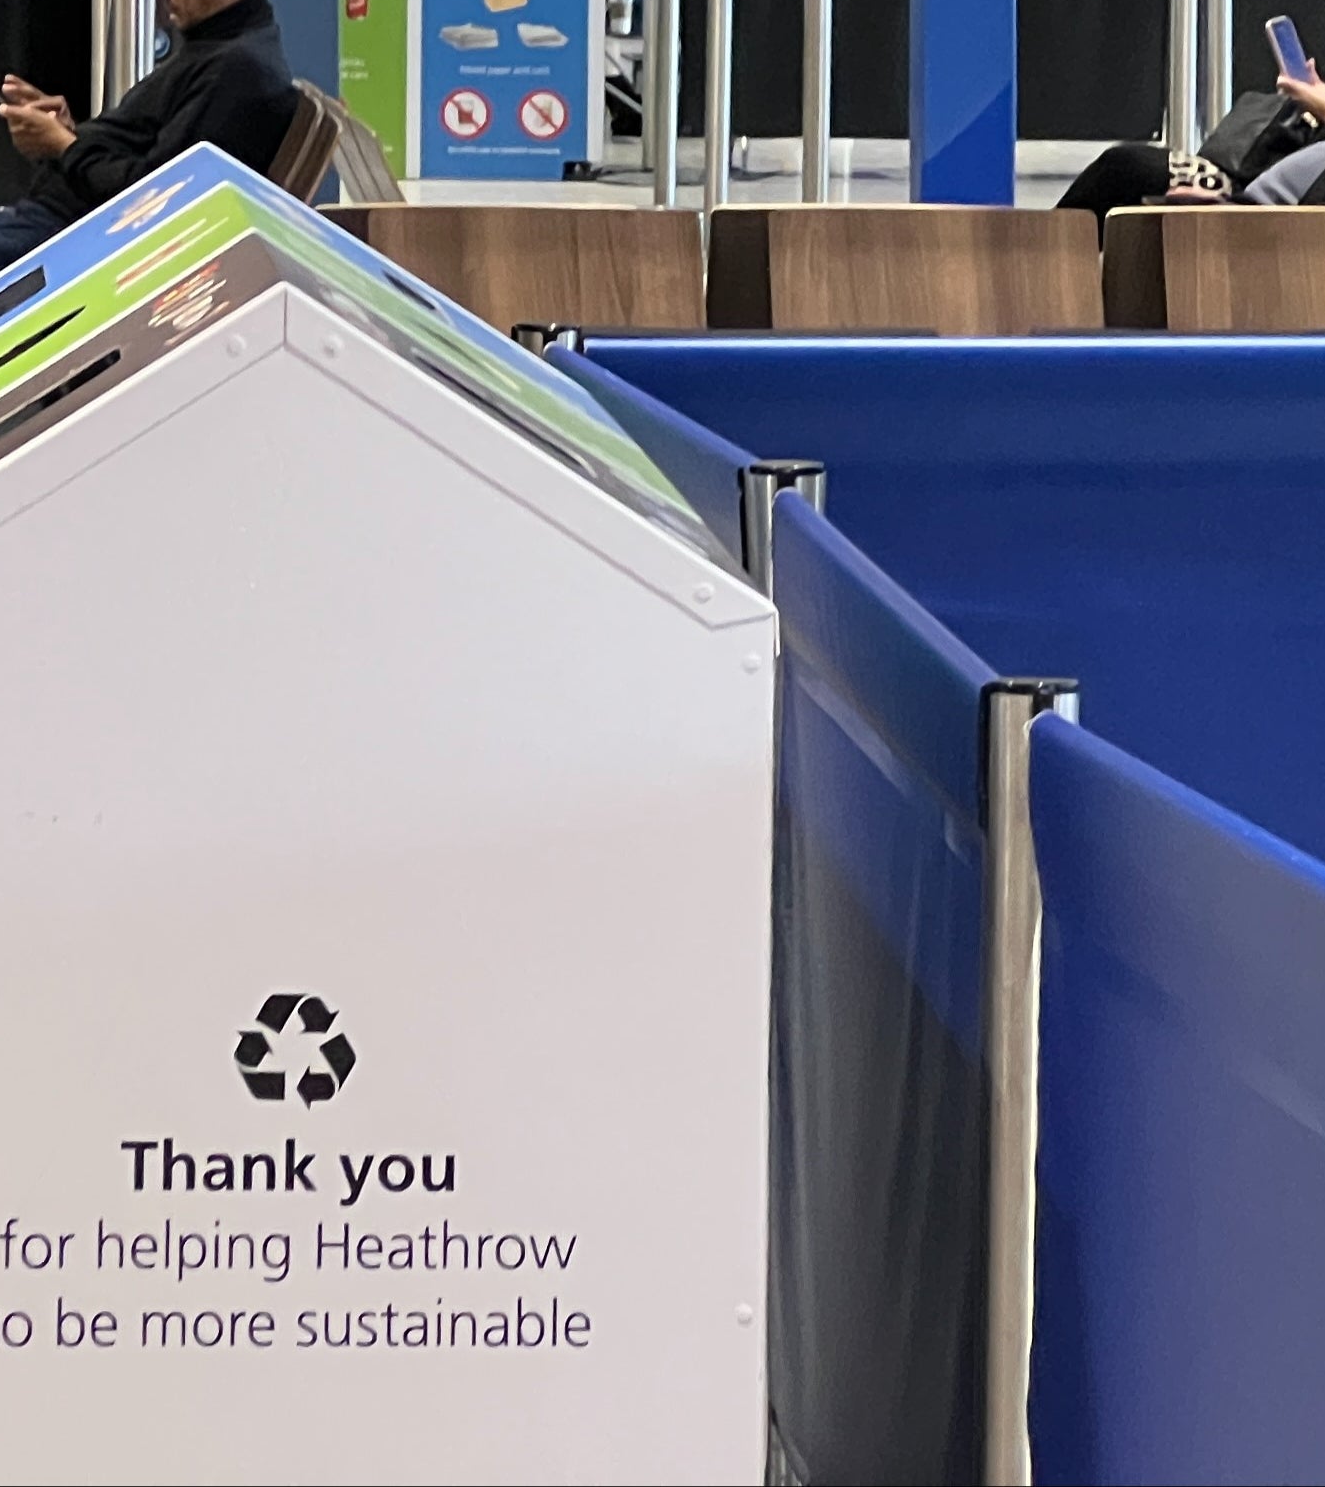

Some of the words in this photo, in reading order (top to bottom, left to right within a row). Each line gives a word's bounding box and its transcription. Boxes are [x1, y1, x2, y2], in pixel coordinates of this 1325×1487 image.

[121, 1139, 316, 1193] Thank
[340, 1151, 456, 1207] you
[0, 1219, 74, 1270] for
[98, 1219, 291, 1283] helping
[316, 1221, 577, 1270] Heathrow
[56, 1298, 118, 1349] be
[140, 1308, 275, 1349] more
[297, 1298, 591, 1350] sustainable
